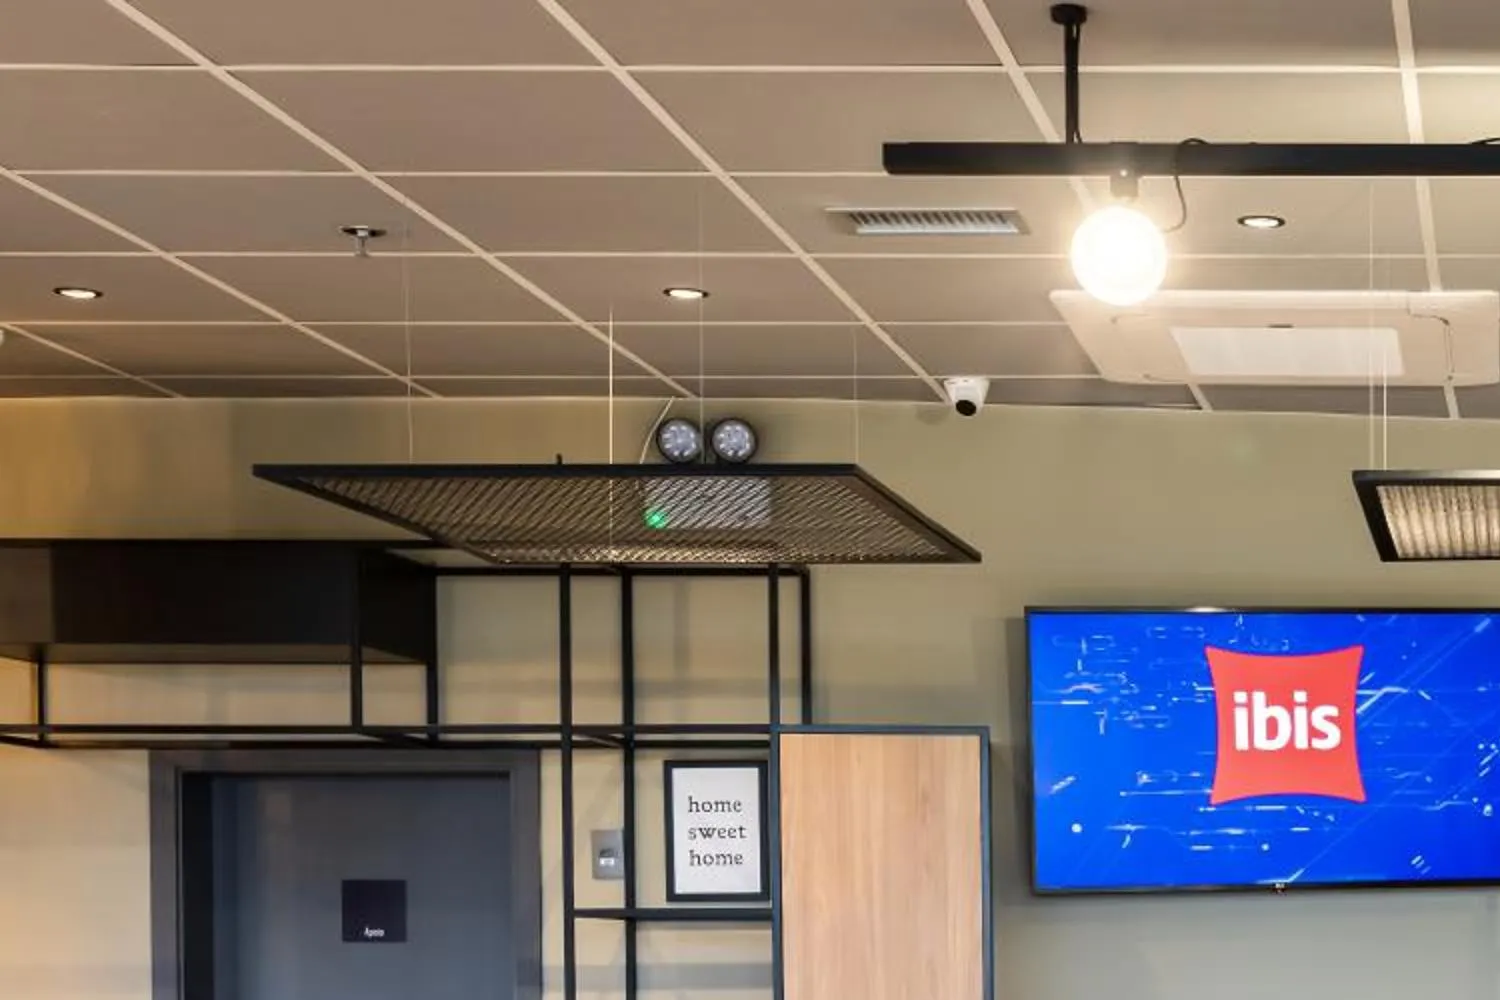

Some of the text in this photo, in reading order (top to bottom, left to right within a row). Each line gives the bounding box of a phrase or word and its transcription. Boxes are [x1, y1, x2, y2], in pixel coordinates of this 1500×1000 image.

[1233, 691, 1342, 751] ibis
[688, 795, 742, 813] home
[687, 825, 747, 840] sweet
[689, 849, 744, 867] home
